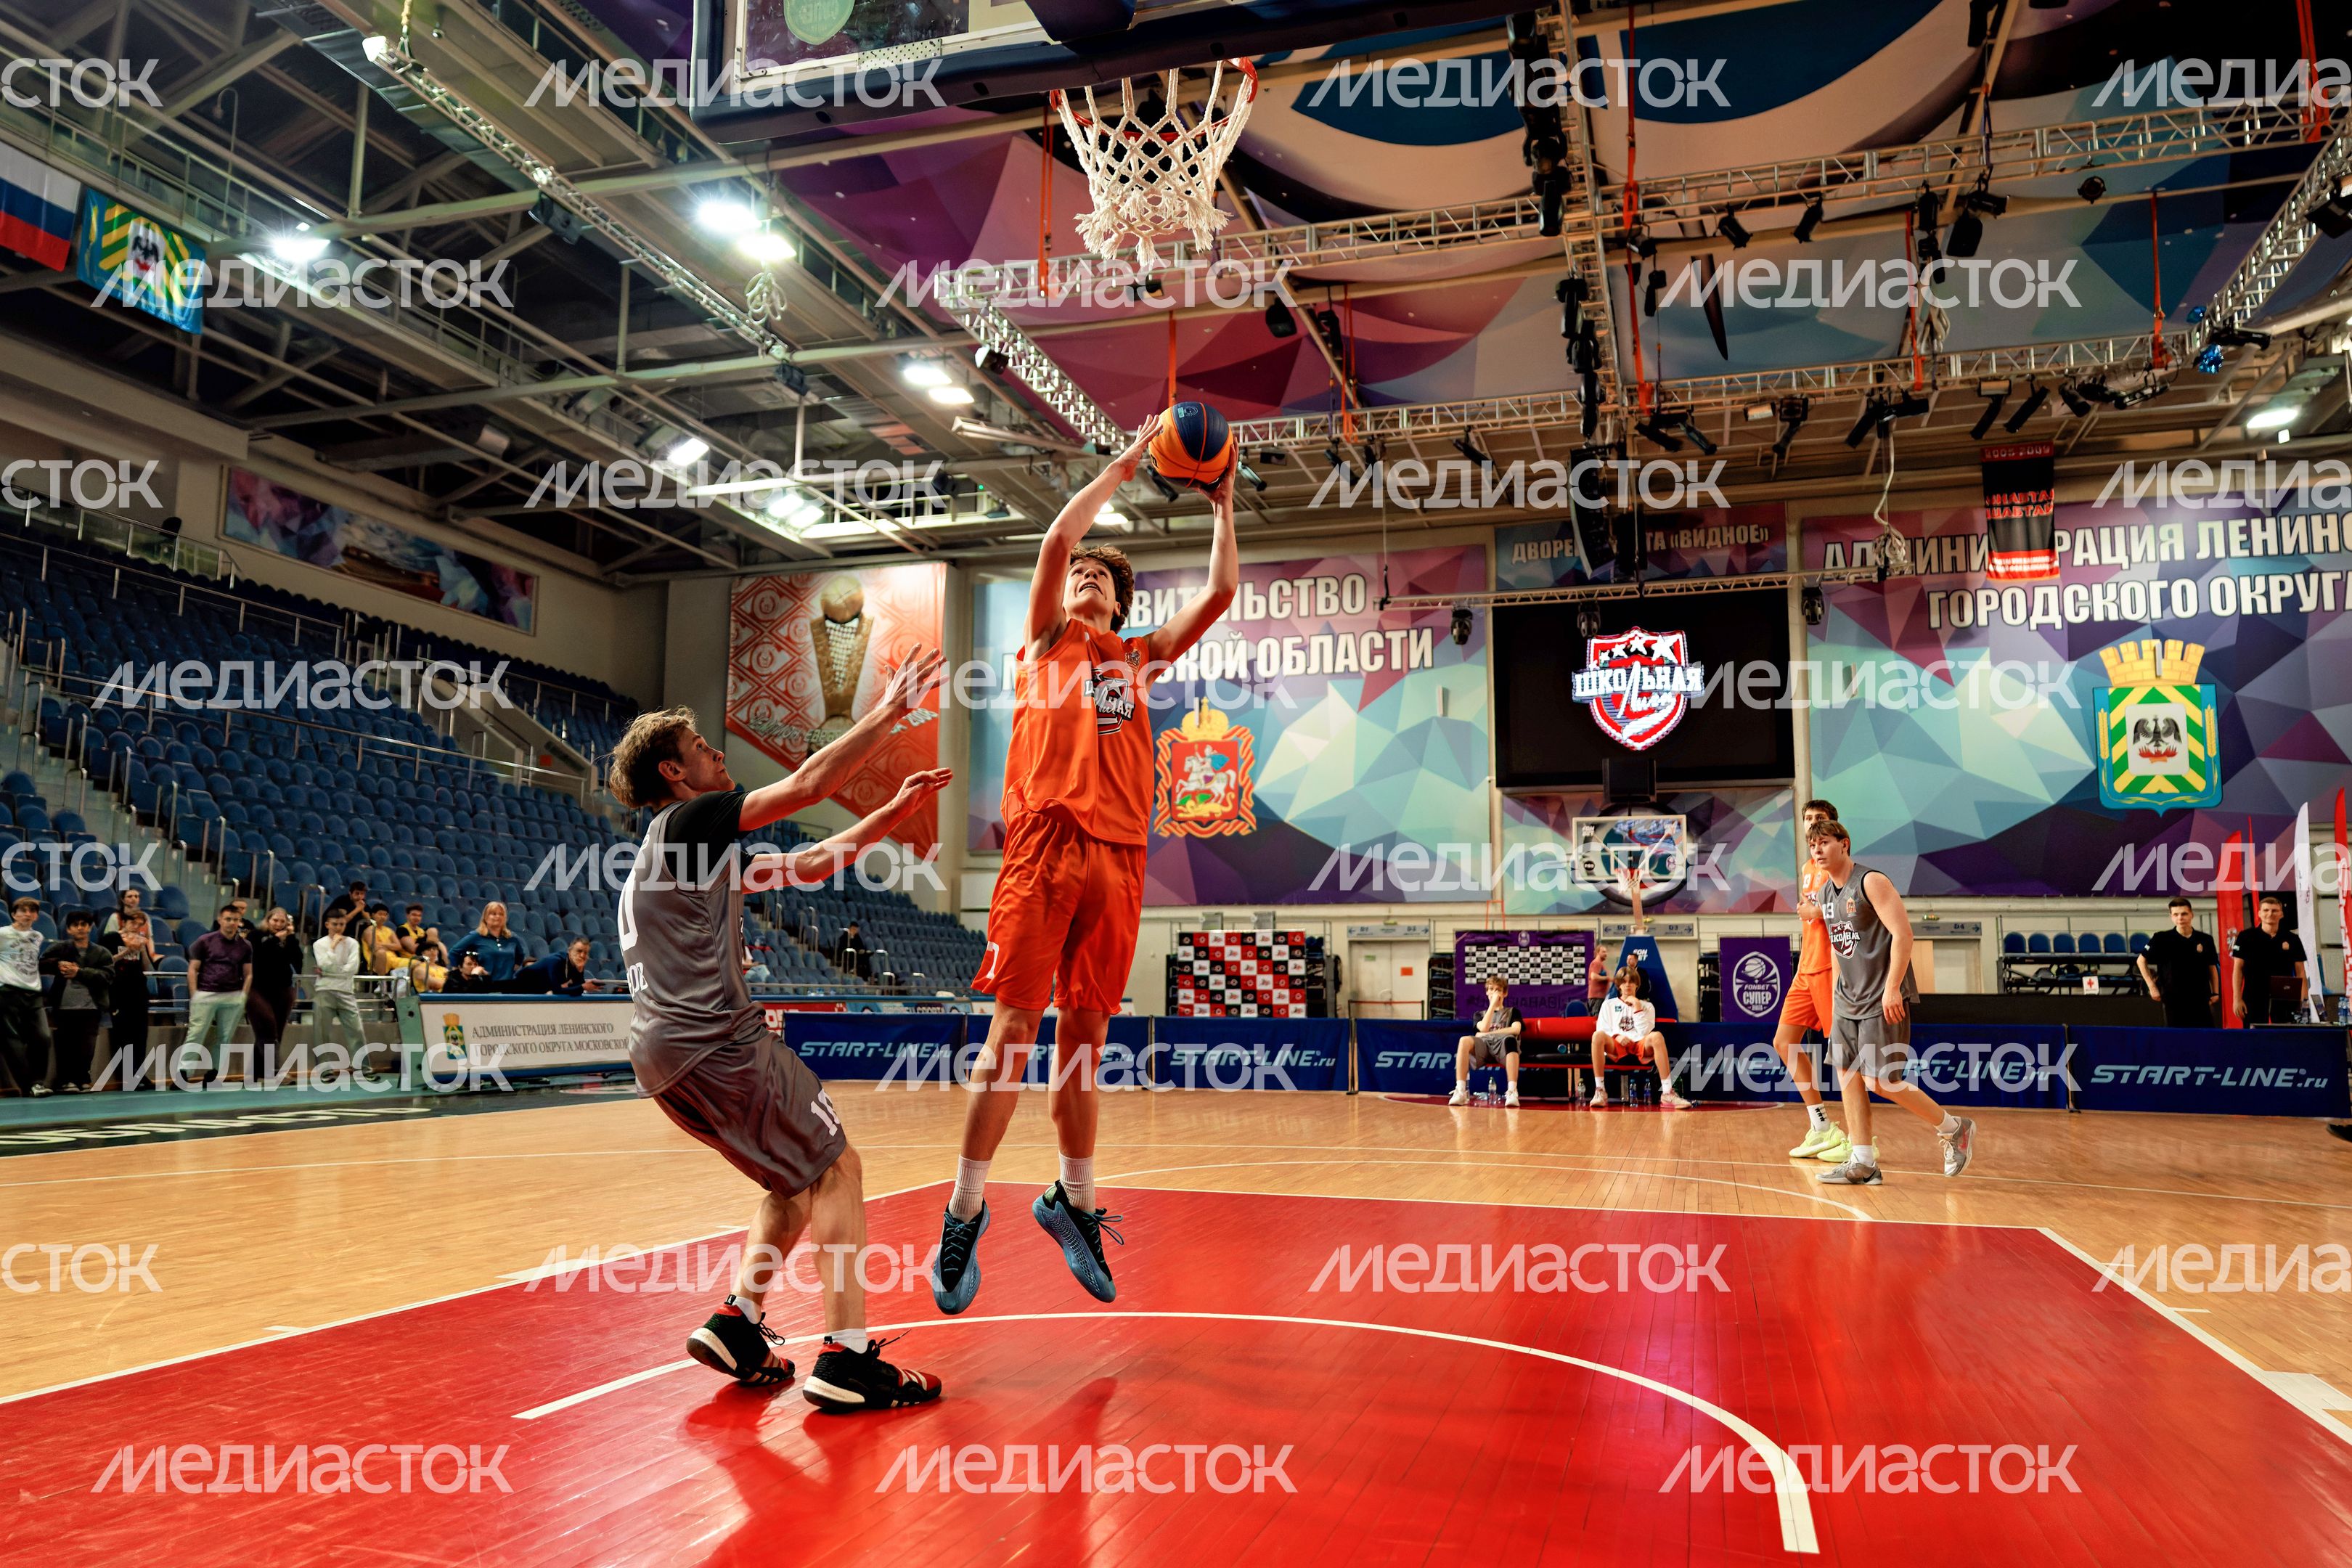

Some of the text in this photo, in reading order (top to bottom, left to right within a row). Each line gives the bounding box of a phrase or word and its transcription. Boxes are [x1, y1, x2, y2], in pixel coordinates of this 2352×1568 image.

[1511, 538, 1581, 564] ДВОРЕ
[1670, 523, 1769, 550] «ВИДНОЕ»
[1928, 577, 2199, 631] ГОРОДСКОГО
[1257, 626, 1434, 679] ОБЛАСТИ
[1575, 661, 1702, 698] ШКОЛЬНАЯ
[1742, 991, 1772, 1005] СУПЕР
[473, 1022, 614, 1038] АДМИНИСТРАЦИЯ ЛЕНИНСКОГО
[474, 1041, 537, 1056] ГОРОДСКОГО
[539, 1040, 573, 1053] ОКРУГА
